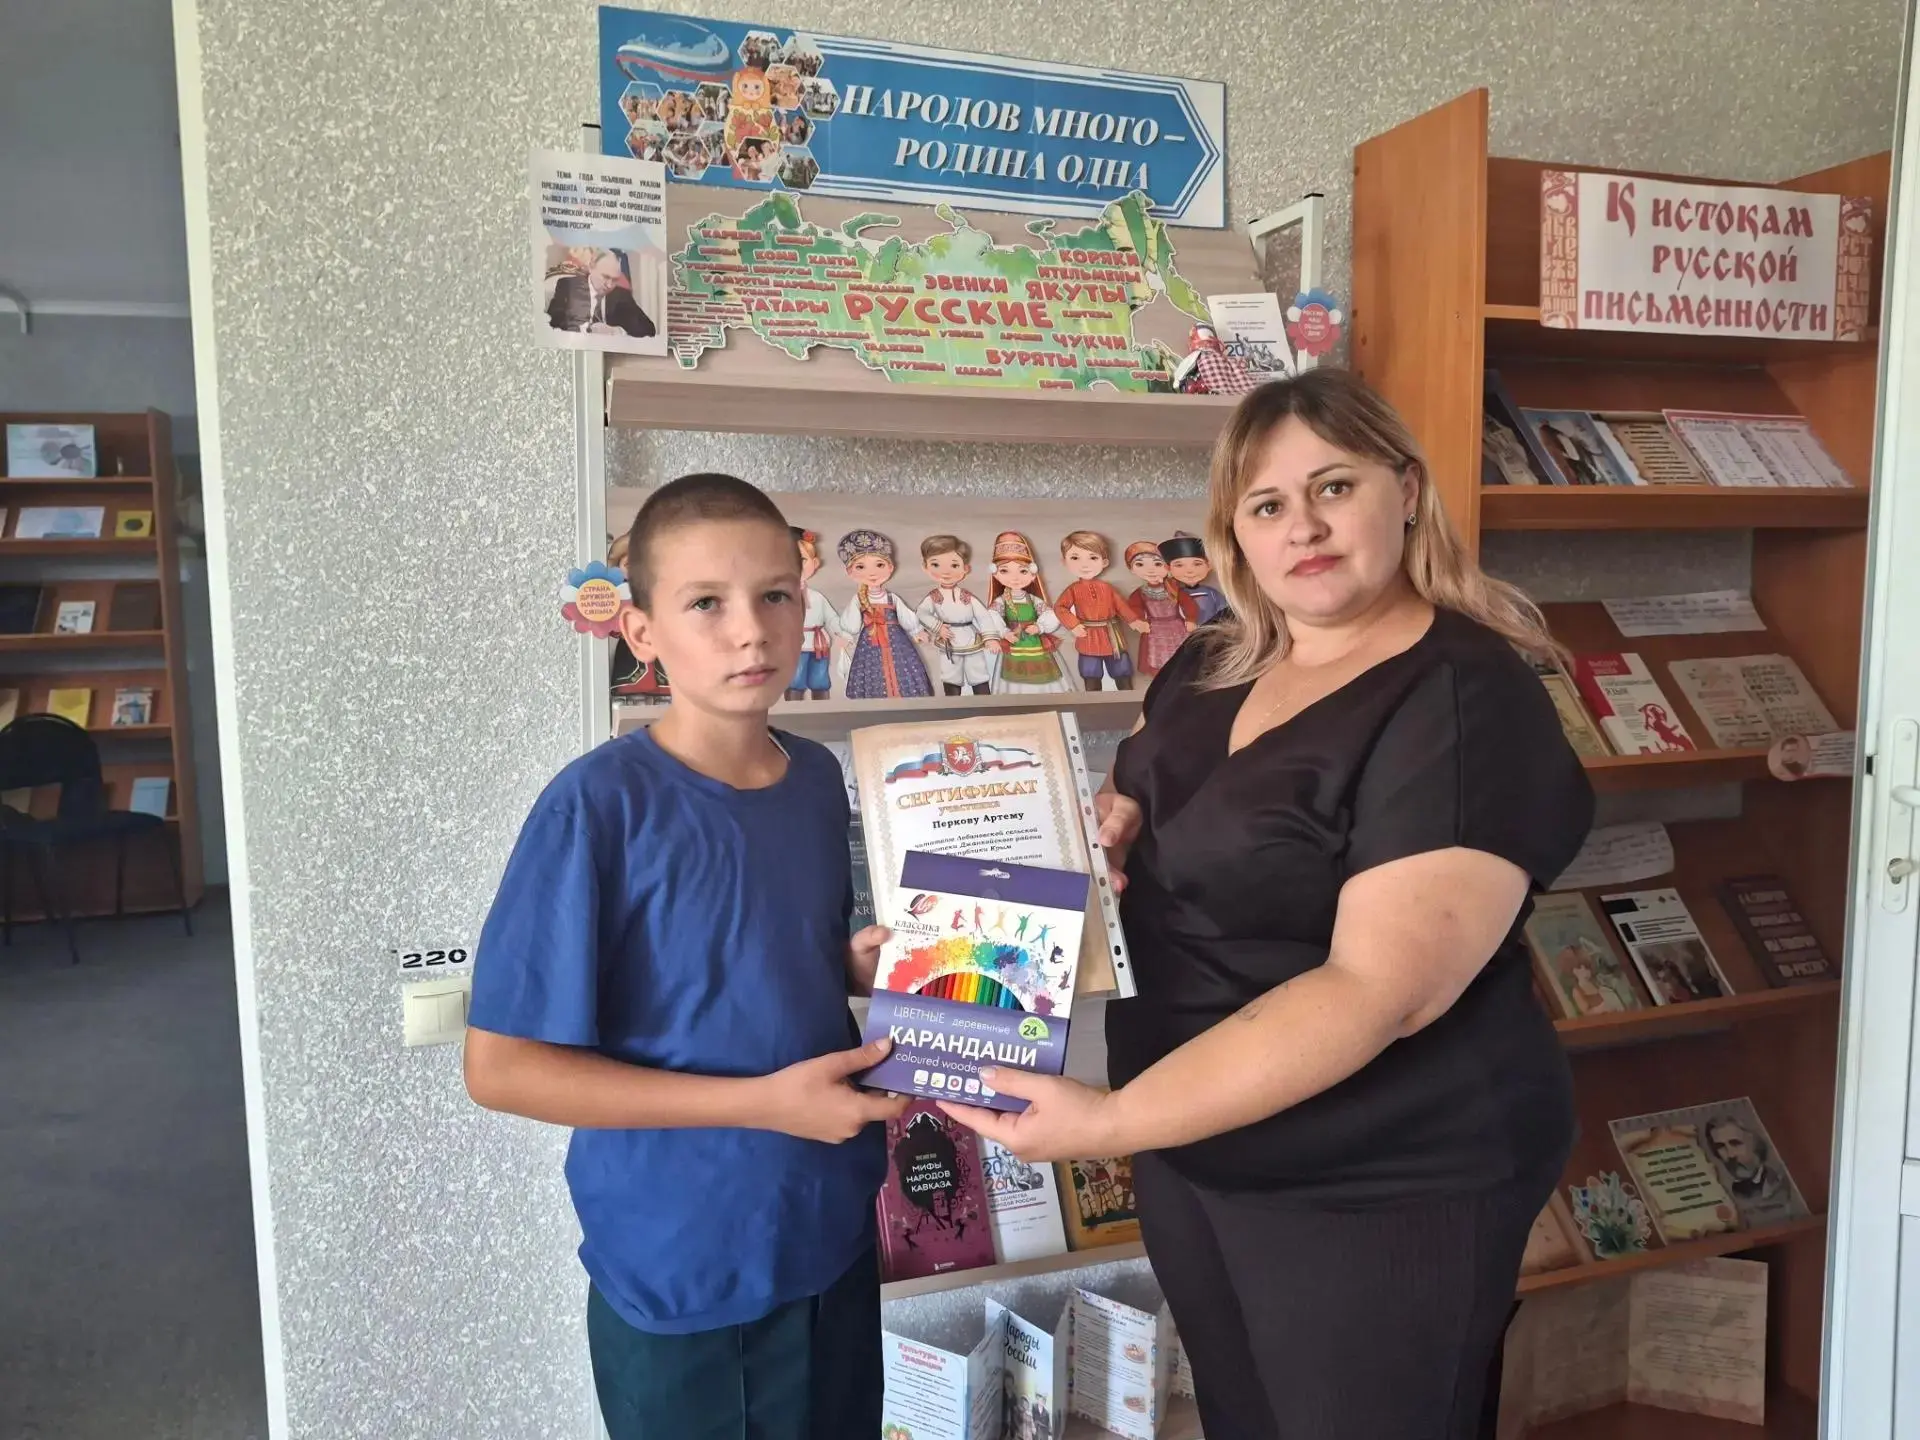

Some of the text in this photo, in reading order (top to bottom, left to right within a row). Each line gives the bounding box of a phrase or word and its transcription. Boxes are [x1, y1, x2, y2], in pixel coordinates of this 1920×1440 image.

[840, 83, 1021, 133] НАРОДОВ
[893, 137, 1149, 190] РОДИНА ОДНА
[556, 170, 572, 178] ТЕМА
[578, 172, 594, 181] ГОДА
[600, 175, 633, 184] ОБЪЯВЛЕНА
[541, 181, 661, 200] ПРЕЗИДЕНТА РОССИЙСКОЙ ФЕДЕРАЦИИ
[1606, 181, 1637, 237] К
[634, 216, 661, 224] ЕДИНСТВА
[1059, 249, 1140, 266] КОРЯКИ
[1038, 266, 1141, 283] ИТЕЛЬМЕНЫ
[924, 275, 1009, 293] ЭВЕНКИ
[1025, 281, 1127, 303] ЯКУТЫ
[742, 297, 829, 314] ТАТАРЫ
[843, 293, 1054, 329] РУССКИЕ
[1052, 333, 1127, 350] ЧУКЧИ
[896, 780, 1038, 810] СЕРТИФИКАТ
[938, 800, 1000, 816] участника
[932, 812, 1025, 829] Перкову Артему
[956, 830, 1004, 842] Лобановской
[1005, 826, 1038, 836] сельской
[1015, 833, 1042, 843] района
[990, 843, 1012, 853] Крым
[894, 920, 940, 933] классика
[402, 948, 468, 969] 220
[893, 1004, 1011, 1036] ЦВЕТНЫЕ деревянные
[1023, 1024, 1038, 1037] 24
[889, 1025, 1037, 1067] КАРАНДАШИ
[895, 1050, 940, 1067] coloured
[912, 1162, 942, 1173] МИФЫ
[983, 1160, 1002, 1177] 20
[906, 1170, 951, 1183] НАРОДОВ
[985, 1175, 1006, 1193] 26
[911, 1180, 952, 1193] КАВКАЗА
[1015, 1197, 1037, 1205] РОССИИ
[897, 1342, 938, 1361] Культура
